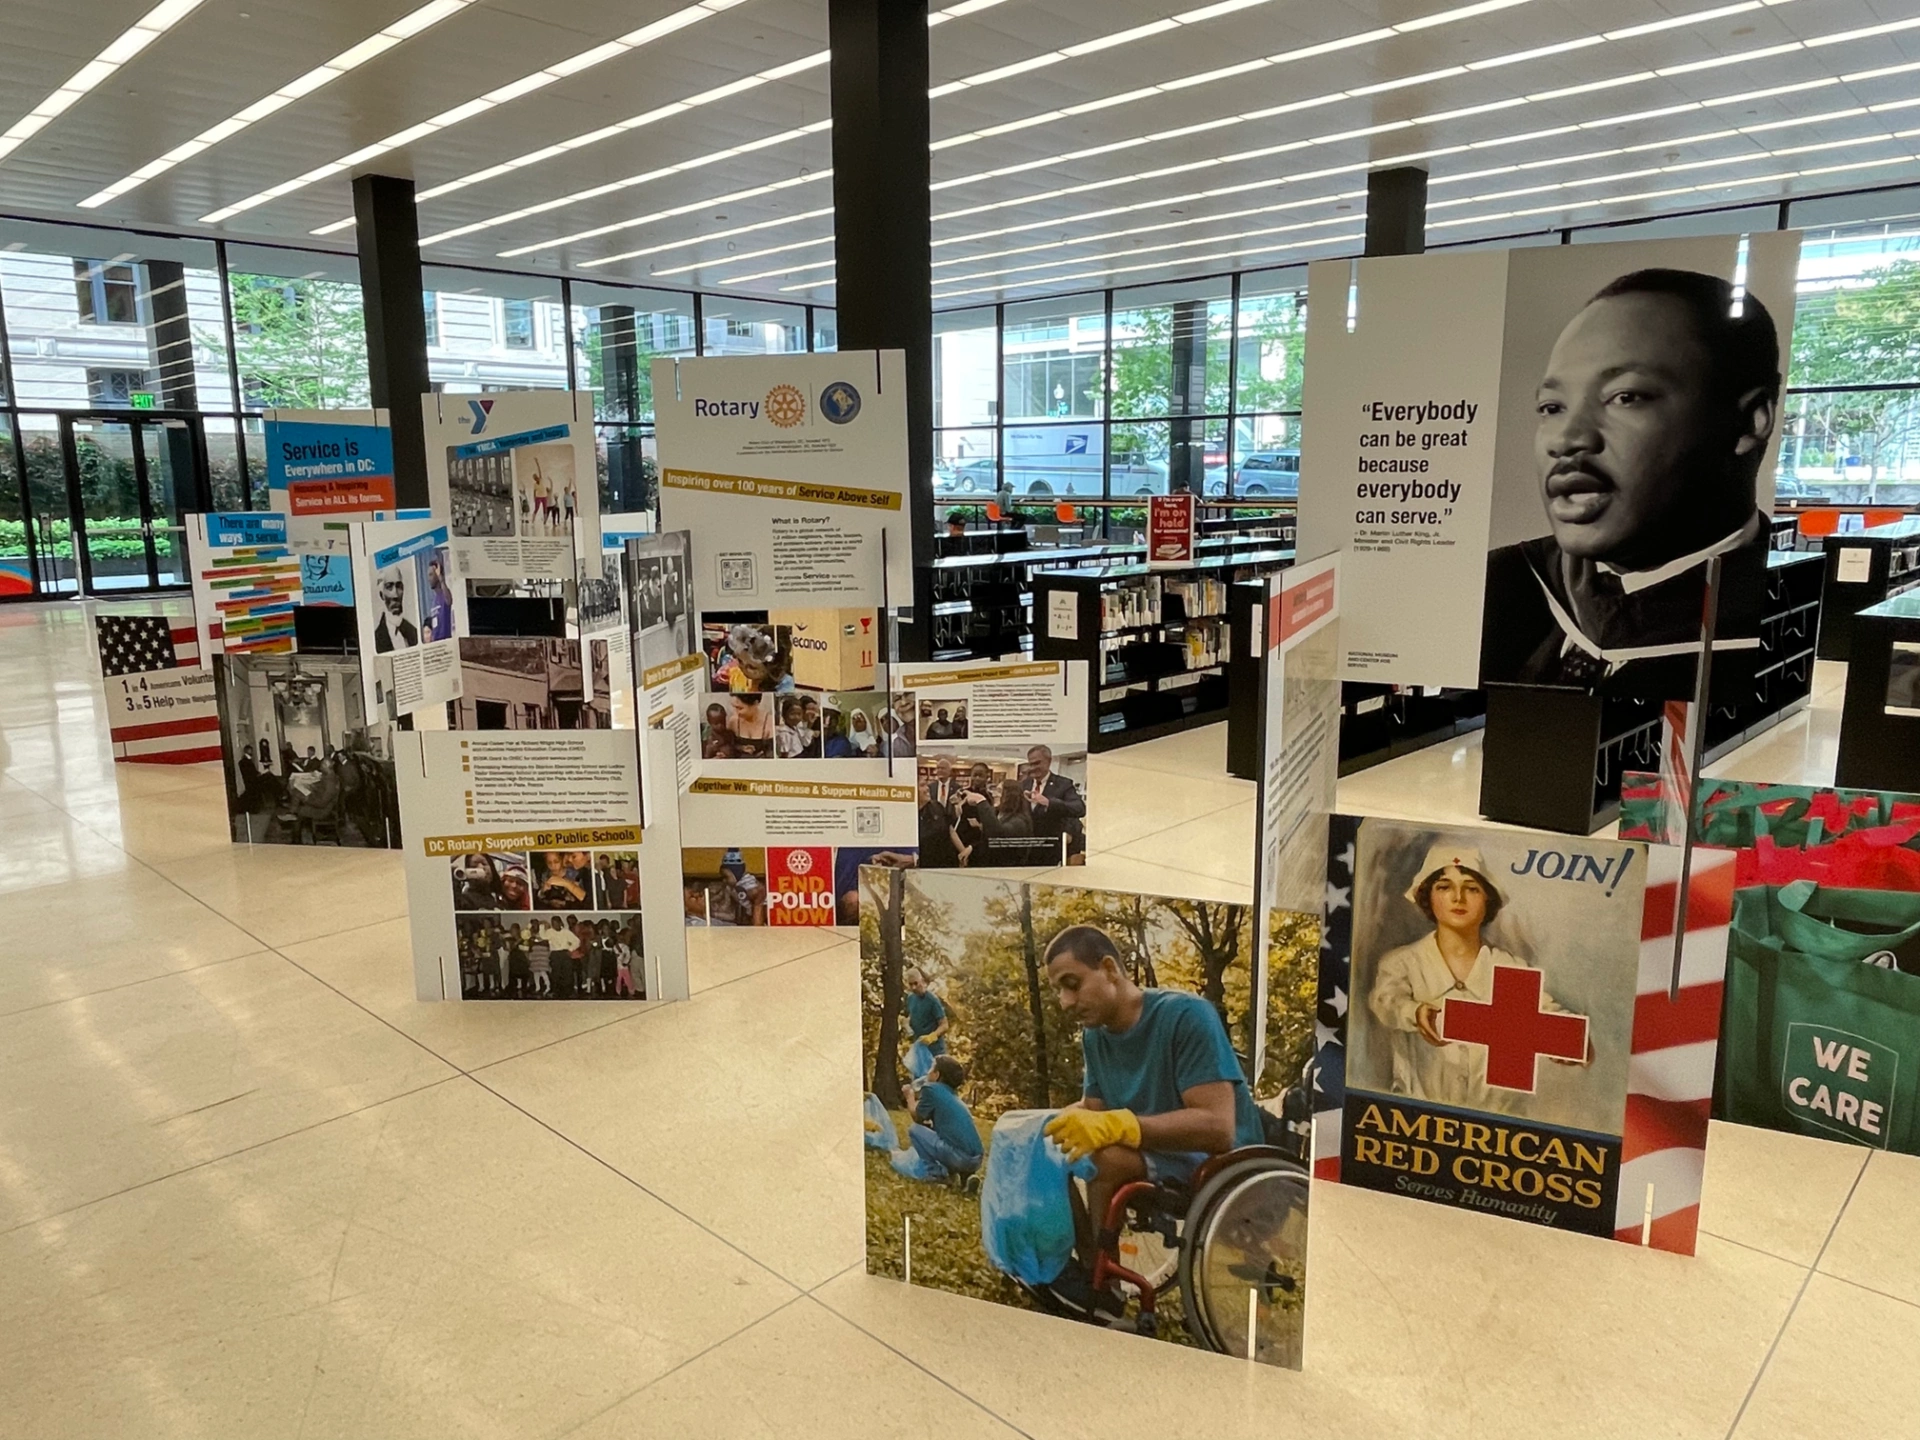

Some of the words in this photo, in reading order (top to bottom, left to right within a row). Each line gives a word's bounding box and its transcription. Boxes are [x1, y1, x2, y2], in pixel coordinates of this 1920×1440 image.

[133, 394, 154, 408] EXIT
[695, 398, 759, 418] Rotary
[1362, 399, 1478, 425] “Everybody
[282, 440, 340, 461] Service
[344, 438, 359, 456] is
[1359, 433, 1390, 448] can
[1395, 430, 1416, 447] be
[1421, 429, 1468, 451] great
[285, 461, 343, 478] Everywhere
[345, 460, 355, 473] in
[357, 459, 375, 472] DC:
[1358, 456, 1429, 473] because
[667, 472, 710, 489] Inspiring
[713, 478, 734, 490] over
[737, 479, 755, 492] 100
[757, 482, 784, 495] years
[786, 485, 797, 496] of
[798, 485, 835, 501] Service
[837, 490, 868, 504] Above
[870, 492, 890, 506] Self
[1357, 479, 1462, 503] everybody
[296, 498, 322, 506] Service
[333, 496, 346, 504] ALL
[1154, 507, 1170, 517] I'm
[1355, 509, 1385, 524] can
[1390, 507, 1452, 525] serve.”
[219, 516, 244, 529] There
[246, 520, 259, 528] are
[261, 520, 284, 532] many
[1159, 518, 1185, 528] hold
[219, 533, 243, 545] ways
[245, 532, 254, 543] to
[792, 636, 828, 651] ecanoo
[121, 679, 129, 694] 1
[139, 677, 148, 692] 4
[126, 697, 135, 711] 3
[142, 695, 152, 709] 5
[153, 696, 175, 708] Help
[694, 780, 732, 793] Together
[733, 781, 747, 792] We
[749, 781, 773, 794] Fight
[775, 783, 810, 795] Disease
[812, 784, 820, 795] &
[821, 785, 857, 799] Support
[859, 786, 888, 798] Health
[890, 788, 912, 799] Care
[428, 840, 445, 852] DC
[447, 837, 483, 853] Rotary
[485, 835, 535, 850] Supports
[537, 834, 553, 846] DC
[555, 831, 590, 845] Public
[592, 829, 635, 843] Schools
[1510, 848, 1636, 898] JOIN!
[777, 876, 826, 893] END
[766, 892, 836, 909] POLIO
[776, 910, 830, 924] NOW
[1813, 1035, 1872, 1082] WE
[1789, 1076, 1884, 1136] CARE
[1355, 1103, 1608, 1176] AMERICAN
[1354, 1134, 1441, 1176] RED
[1452, 1155, 1603, 1210] CROSS
[1394, 1174, 1455, 1201] Serves
[1459, 1187, 1558, 1225] Humanity
